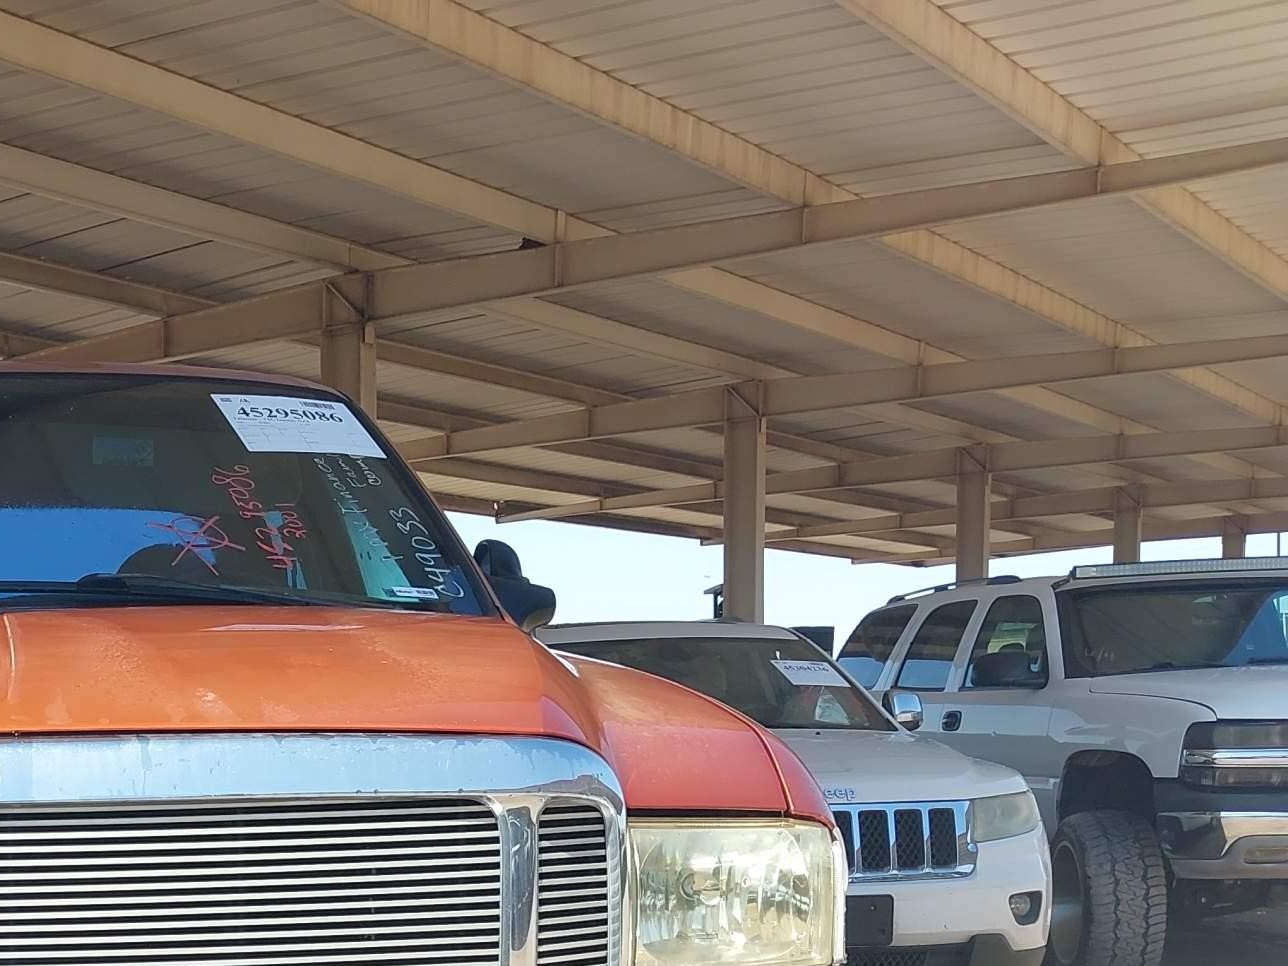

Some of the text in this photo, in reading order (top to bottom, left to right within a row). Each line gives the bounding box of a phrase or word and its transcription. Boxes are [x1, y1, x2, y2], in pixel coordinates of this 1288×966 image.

[237, 406, 344, 424] 45295086
[389, 506, 465, 598] C49033
[823, 788, 856, 802] eep
